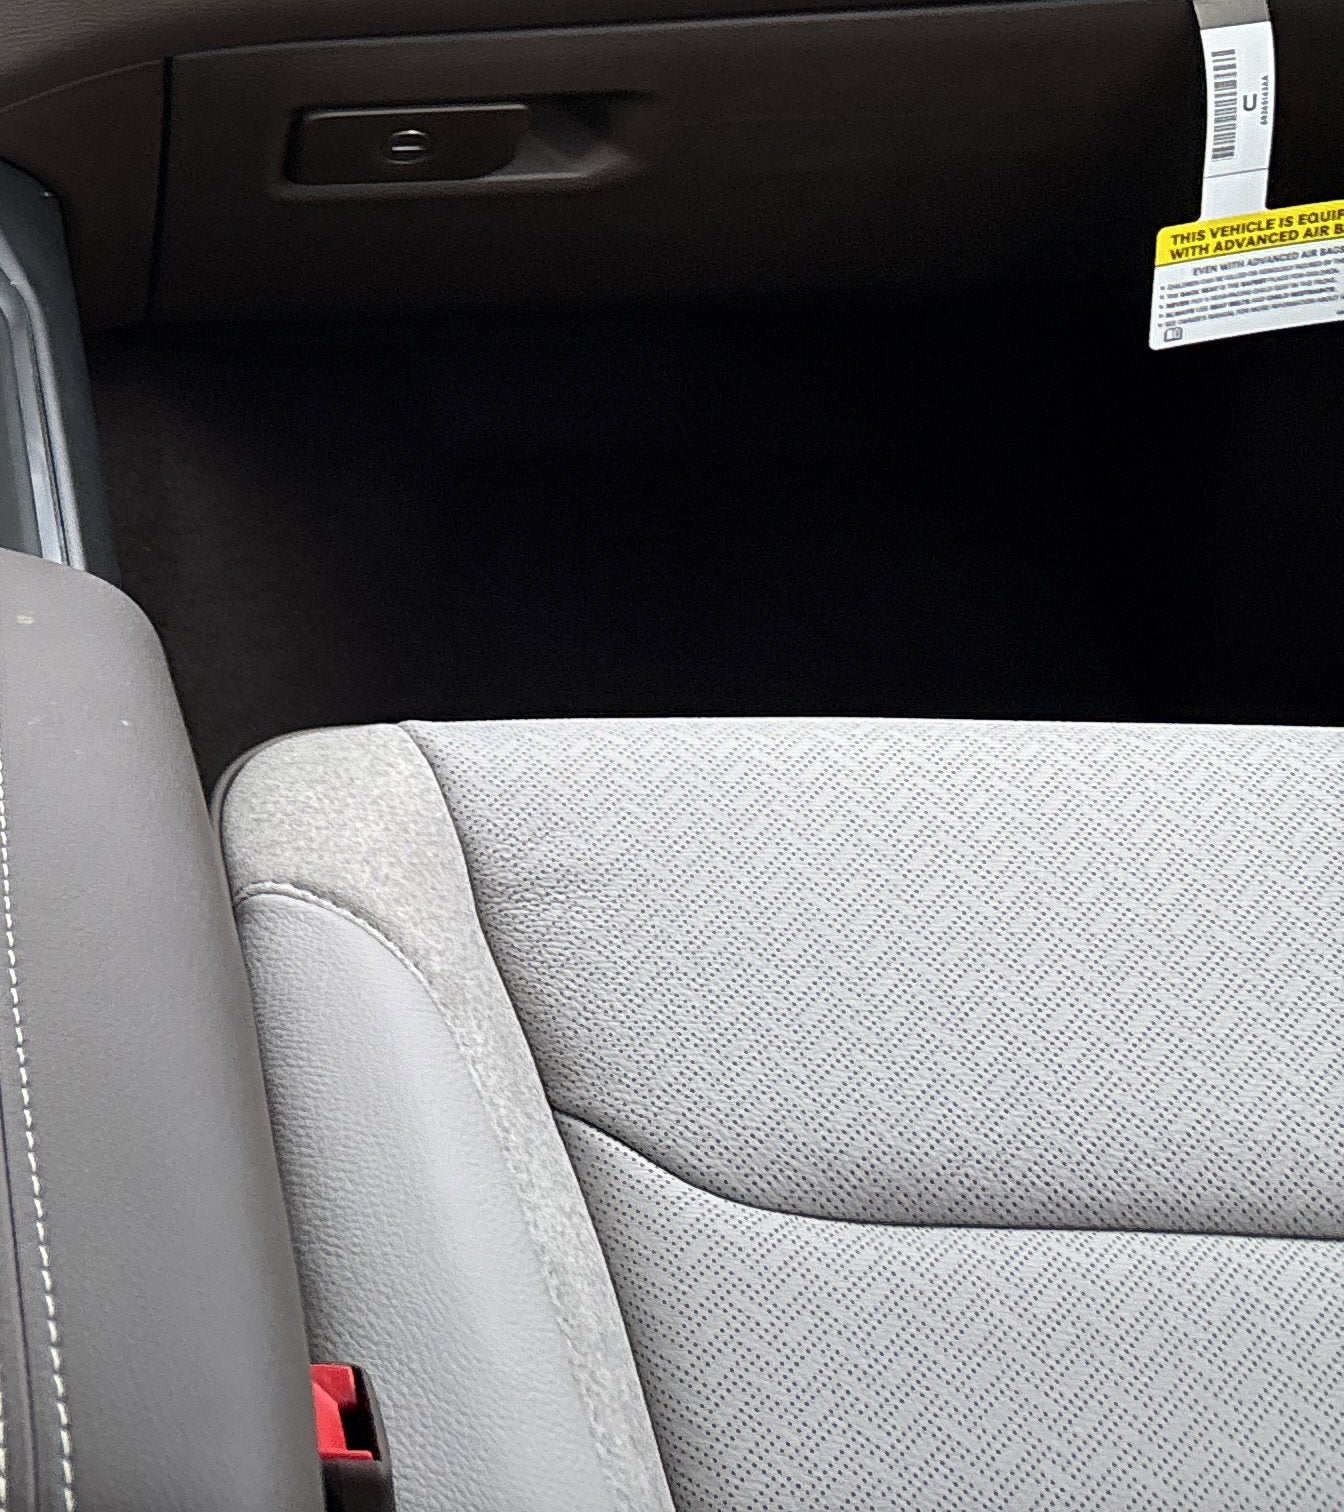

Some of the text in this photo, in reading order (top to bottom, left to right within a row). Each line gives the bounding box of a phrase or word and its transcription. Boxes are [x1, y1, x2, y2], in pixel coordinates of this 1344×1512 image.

[1242, 93, 1257, 112] U
[1170, 229, 1206, 246] THIS
[1210, 217, 1276, 238] VEHICLE
[1278, 215, 1294, 228] IS
[1170, 244, 1210, 260] WITH
[1213, 229, 1299, 253] ADVANCED
[1303, 224, 1330, 239] AIR
